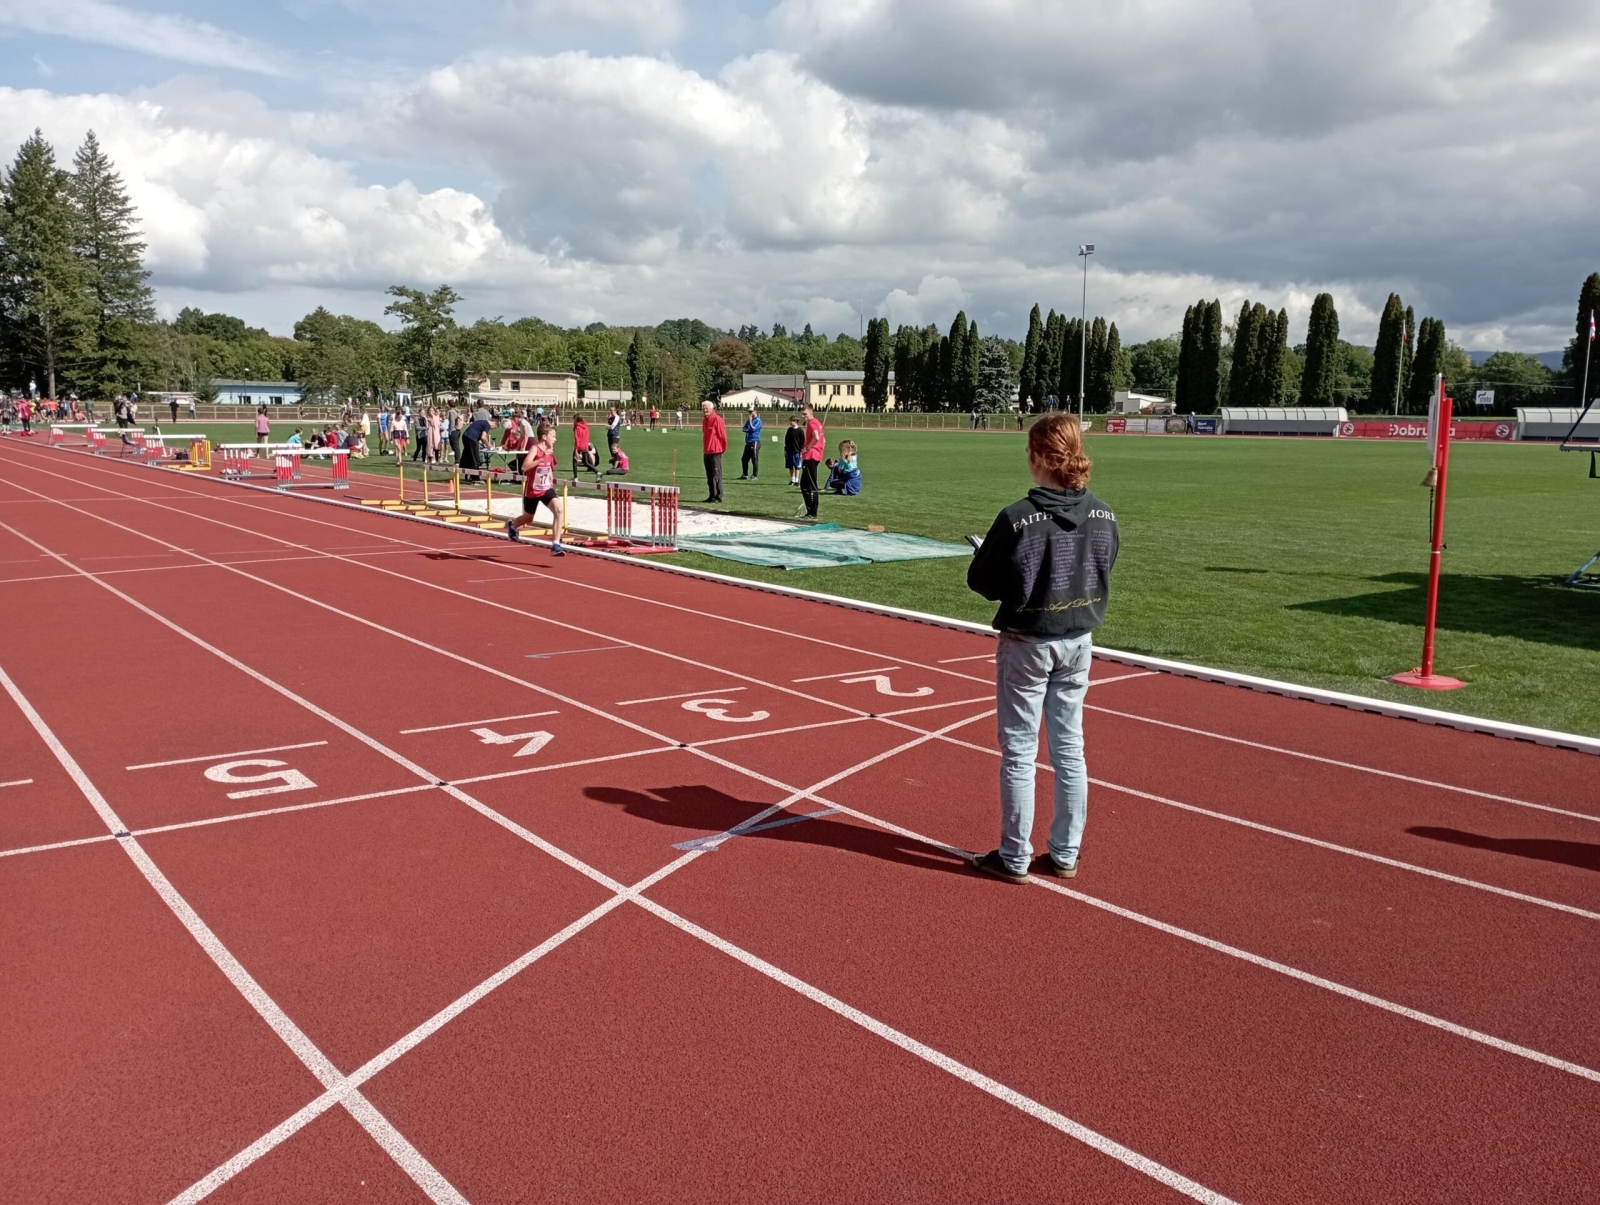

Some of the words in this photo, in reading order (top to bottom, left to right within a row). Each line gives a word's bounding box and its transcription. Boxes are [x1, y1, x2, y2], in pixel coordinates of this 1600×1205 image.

[1389, 424, 1456, 437] Dobrua
[540, 474, 547, 485] 17
[1012, 512, 1053, 532] FAITH
[840, 674, 935, 698] 2
[681, 697, 770, 723] 3
[470, 727, 556, 758] 4
[203, 757, 318, 800] 5
